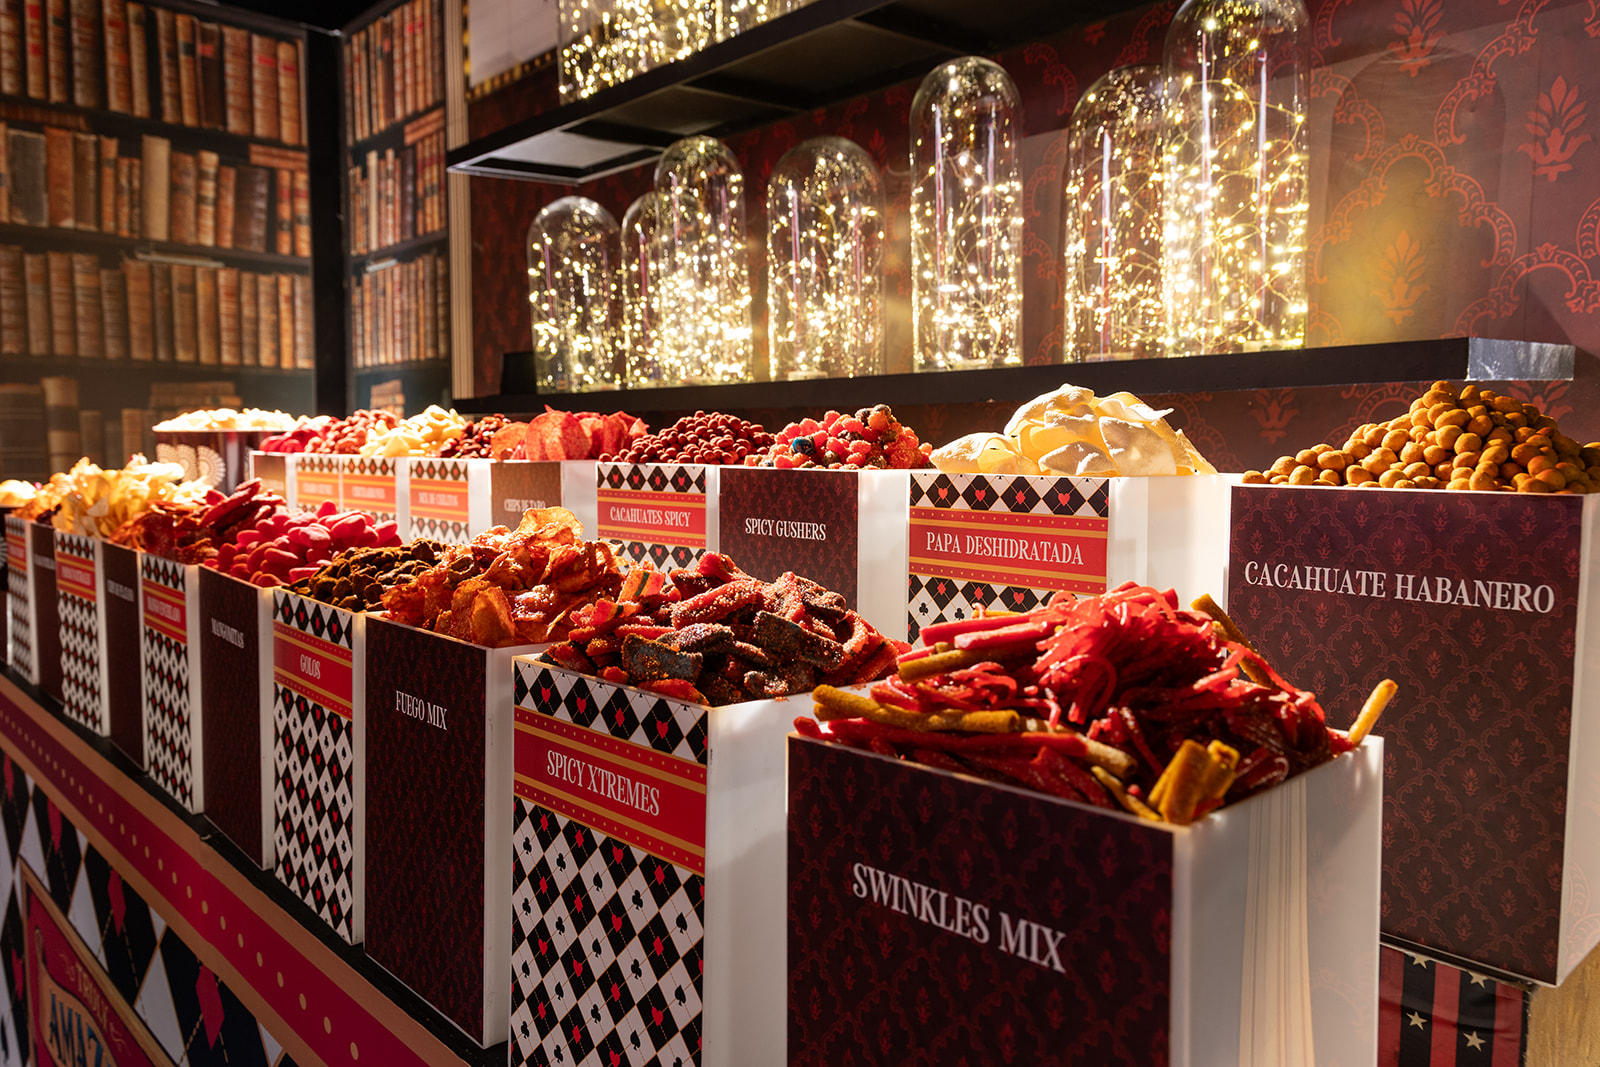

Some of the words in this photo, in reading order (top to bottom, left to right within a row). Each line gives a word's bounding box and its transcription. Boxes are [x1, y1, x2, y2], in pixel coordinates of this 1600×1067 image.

[609, 505, 663, 526] CACAHUATES
[664, 509, 691, 529] SPICY
[744, 517, 776, 539] SPICY
[776, 520, 827, 542] GUSHERS
[926, 530, 962, 554] PAPA
[965, 534, 1084, 566] DESHIDRATADA
[1243, 560, 1387, 598] CACAHUATE
[1393, 573, 1556, 614] HABANERO
[300, 653, 321, 680] GOLOS
[395, 690, 425, 721] FUEGO
[427, 702, 448, 731] MIX
[547, 749, 586, 788] SPICY
[586, 763, 660, 817] XTREMES
[852, 861, 991, 944] SWINKLES
[997, 911, 1067, 974] MIX
